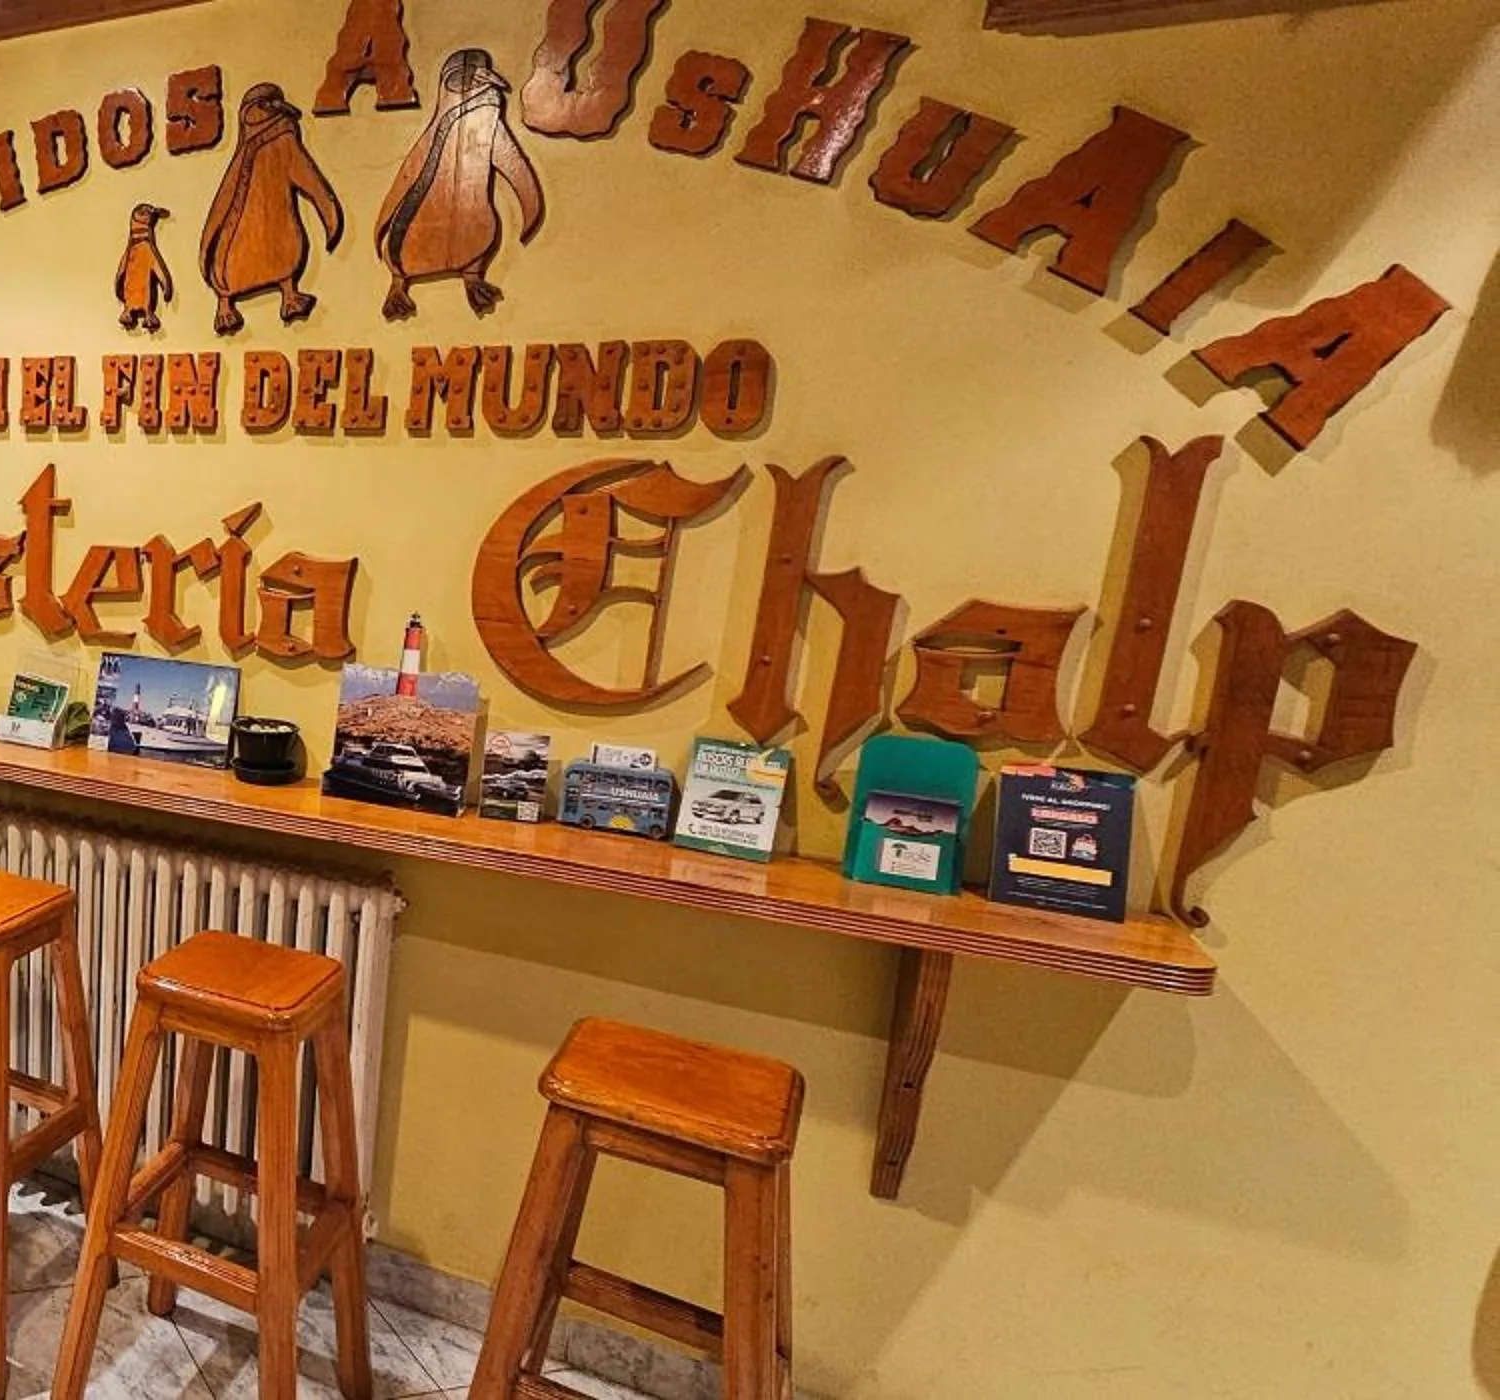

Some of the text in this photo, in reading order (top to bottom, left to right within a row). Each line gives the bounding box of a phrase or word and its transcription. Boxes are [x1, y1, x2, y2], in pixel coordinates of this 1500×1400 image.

[21, 355, 87, 433] EL
[100, 351, 222, 434] FIN
[241, 348, 388, 435] DEL
[404, 338, 774, 438] MUNDO
[313, 0, 421, 117] A
[520, 0, 1453, 453] USHUAIA
[470, 433, 1419, 928] Chalp
